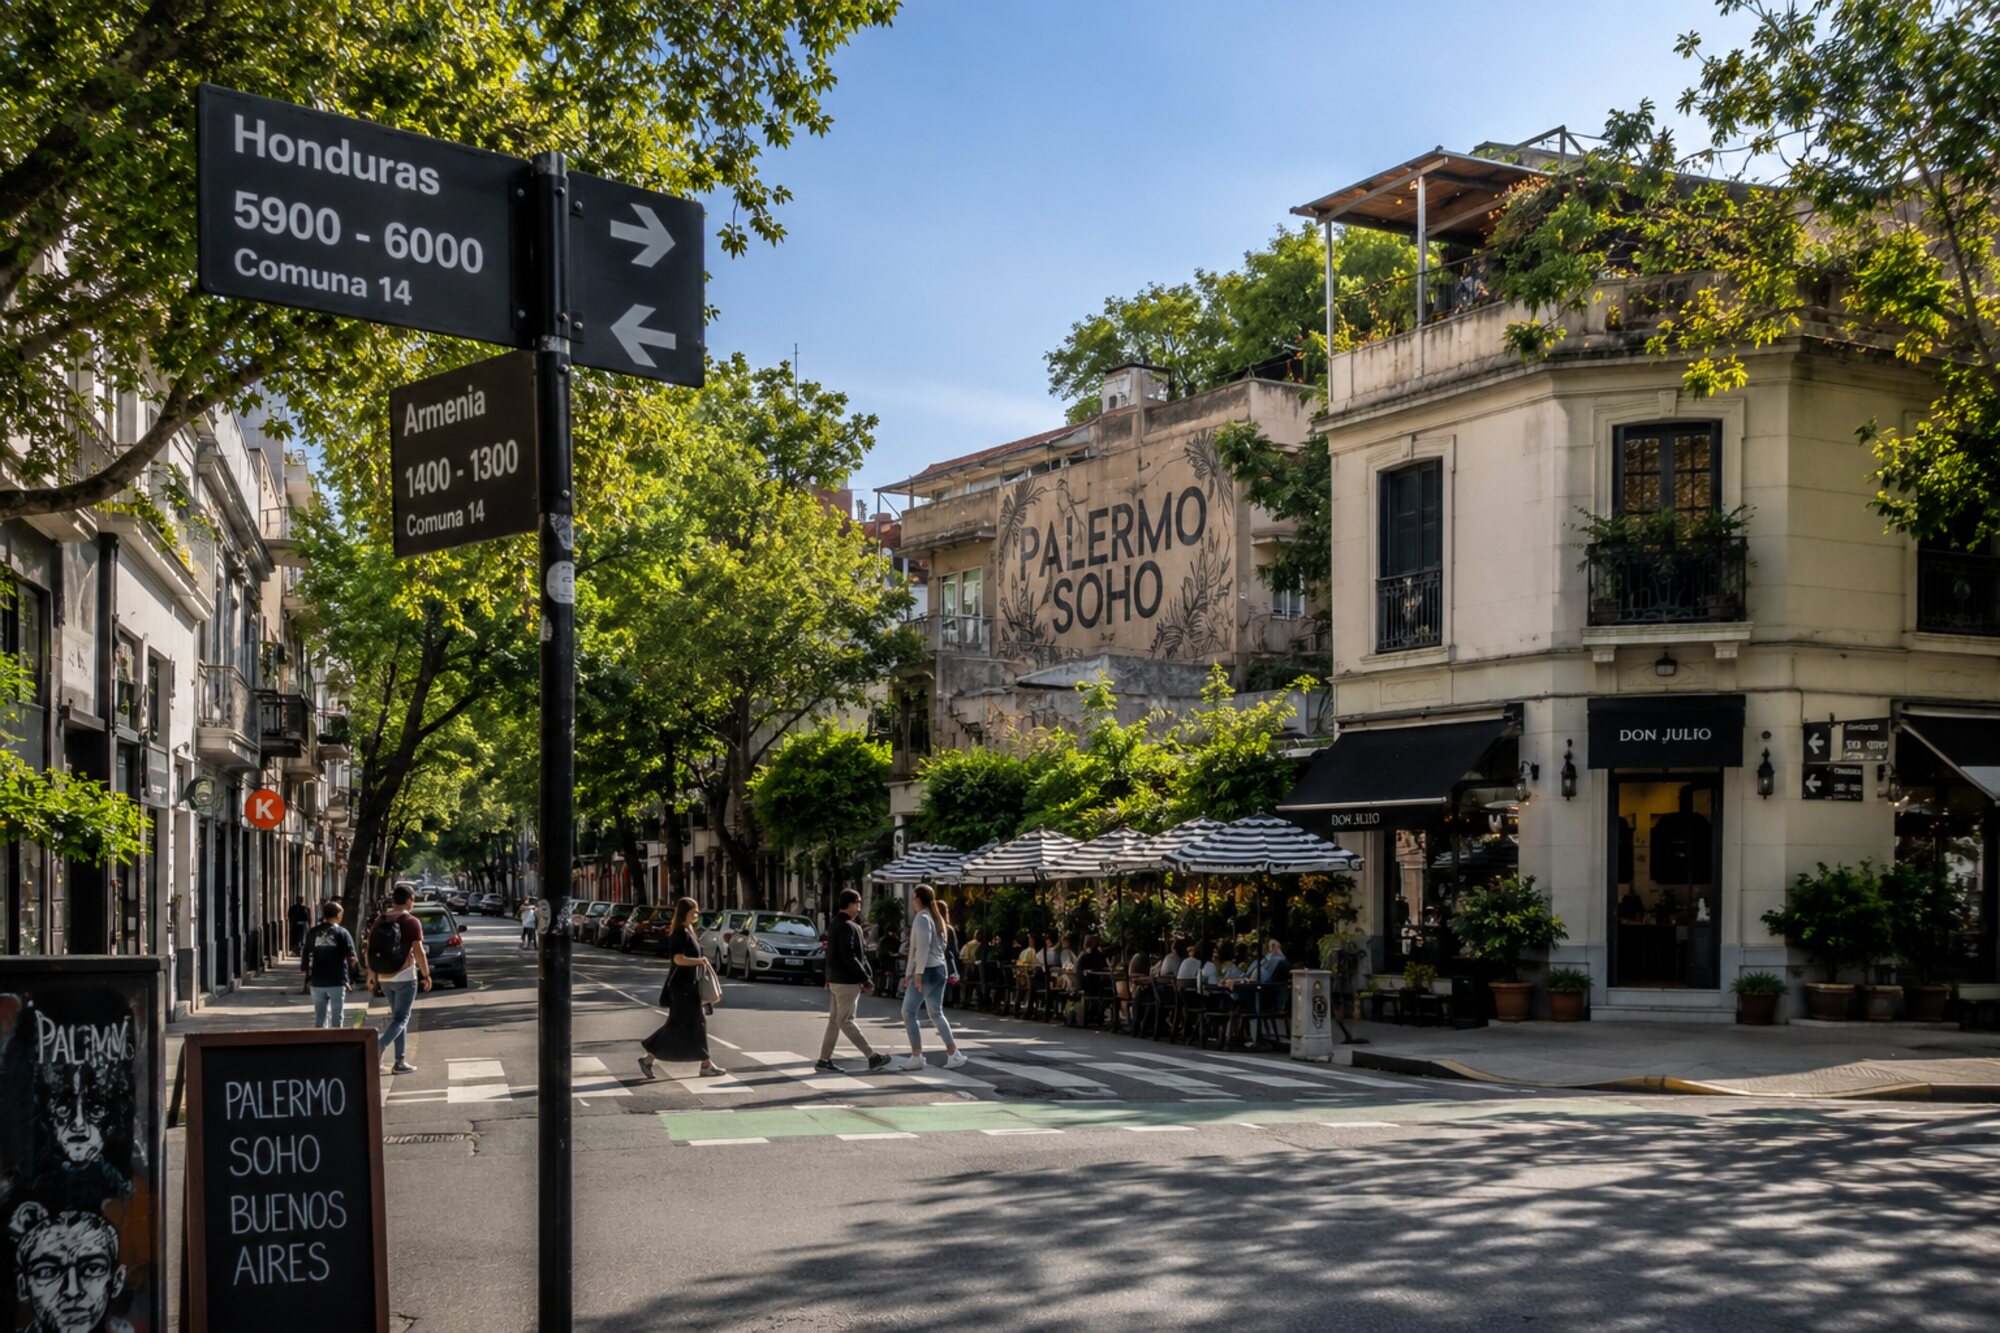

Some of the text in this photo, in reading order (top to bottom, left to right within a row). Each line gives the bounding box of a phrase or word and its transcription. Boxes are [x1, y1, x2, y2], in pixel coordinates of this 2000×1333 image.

[233, 113, 441, 196] Honduras
[233, 189, 342, 247] 5900
[384, 221, 484, 275] 6000
[233, 248, 413, 307] Comuna 14
[403, 384, 487, 438] Armenia
[404, 458, 451, 499] 1400
[469, 439, 519, 484] 1300
[406, 499, 485, 538] Comuna 14
[1020, 485, 1207, 582] PALERMO
[1053, 560, 1163, 634] SOHO
[1620, 728, 1711, 743] DON JULIO
[256, 798, 275, 820] K
[224, 1077, 347, 1121] PALERMO
[229, 1134, 321, 1177] SOHO
[230, 1190, 348, 1236] BUENOS
[232, 1241, 331, 1288] AIRES
